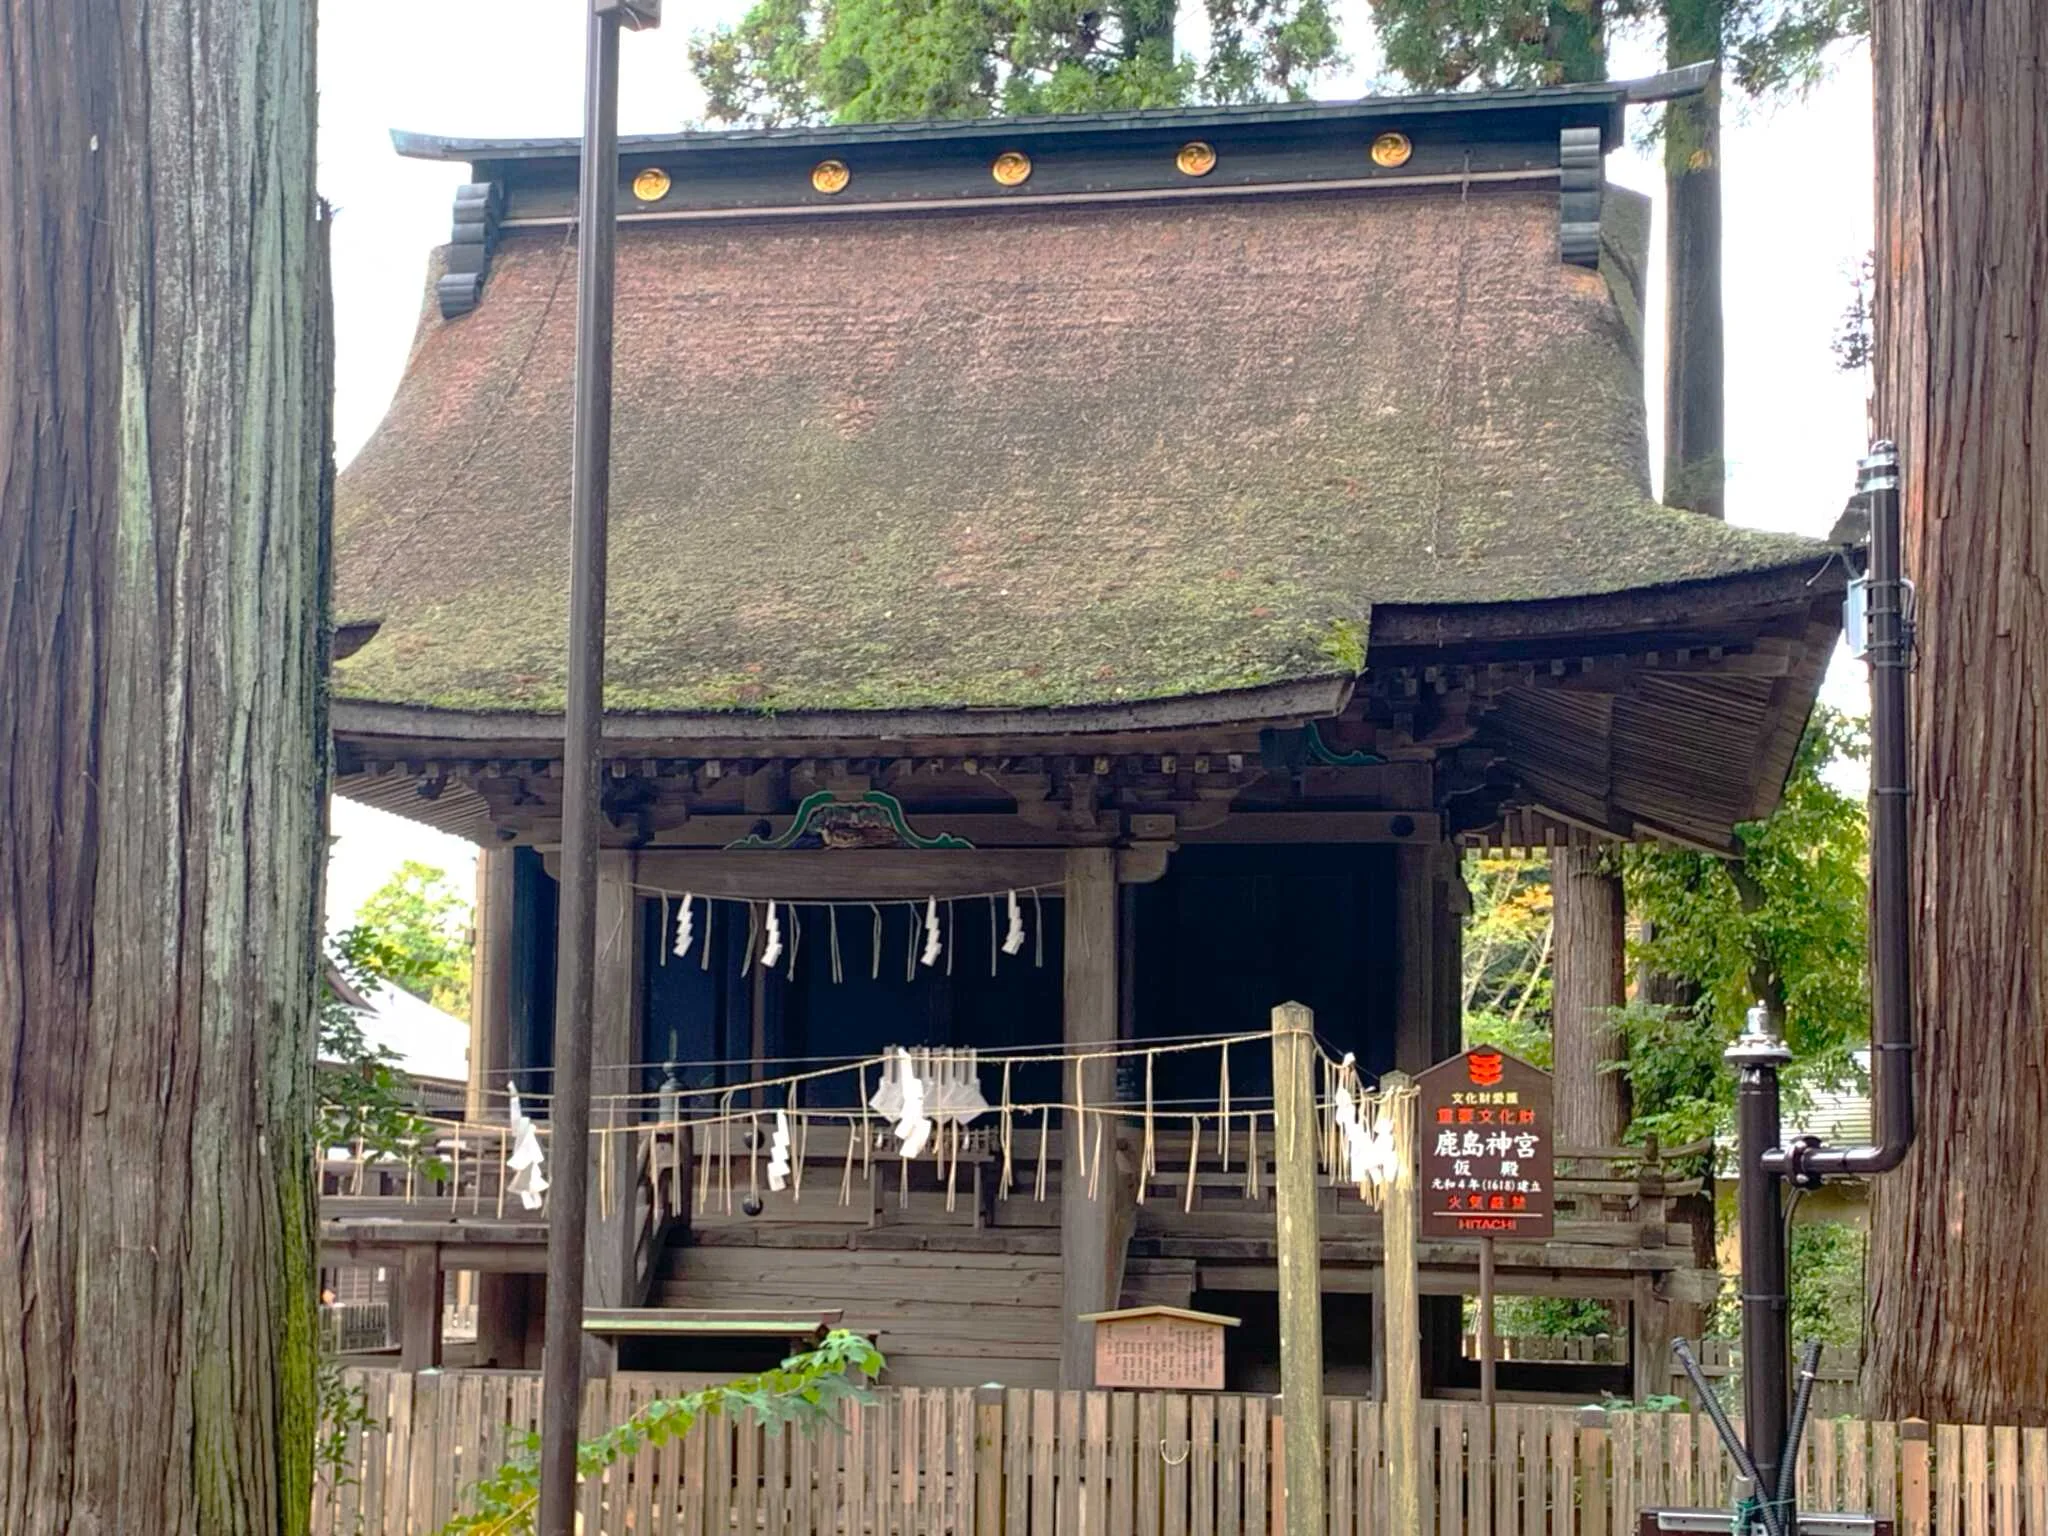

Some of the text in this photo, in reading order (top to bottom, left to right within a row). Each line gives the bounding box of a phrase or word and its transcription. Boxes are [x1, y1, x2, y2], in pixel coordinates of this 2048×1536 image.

[1434, 1129, 1540, 1158] 鹿島神宮
[1458, 1219, 1517, 1230] HITACHI
